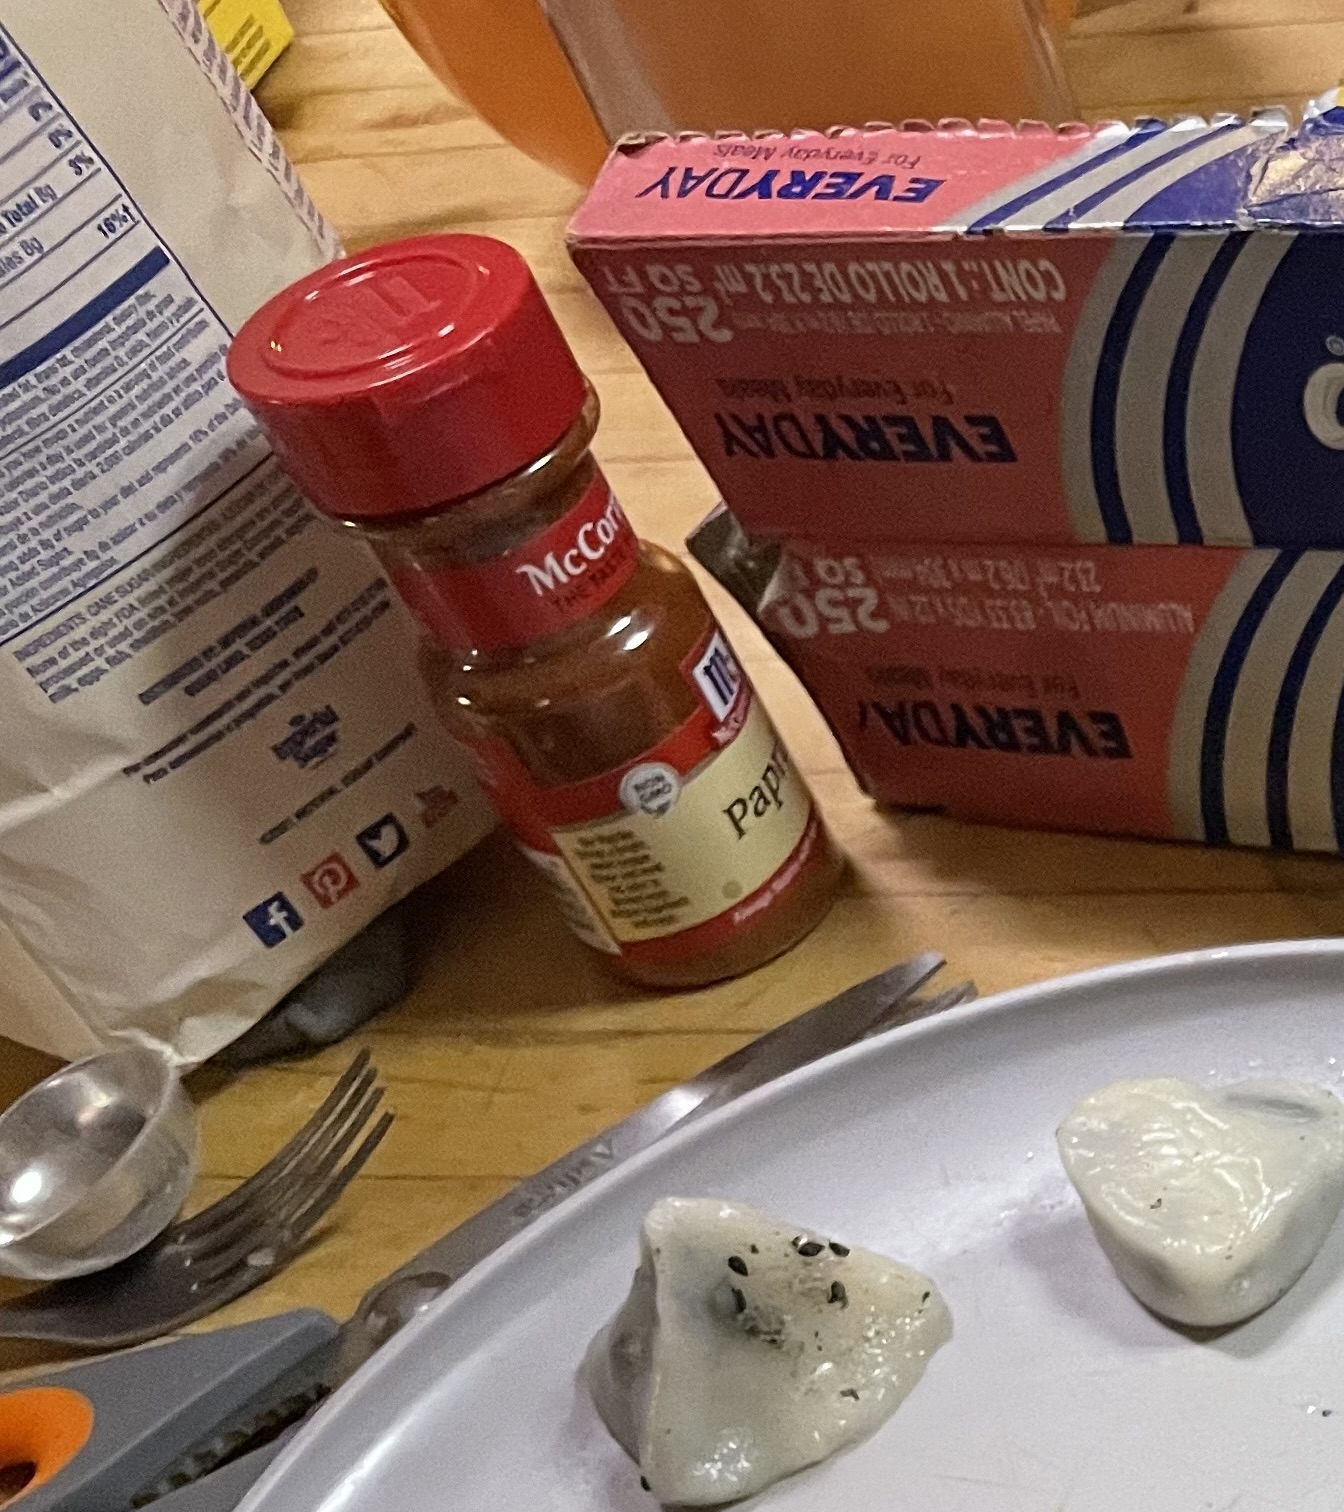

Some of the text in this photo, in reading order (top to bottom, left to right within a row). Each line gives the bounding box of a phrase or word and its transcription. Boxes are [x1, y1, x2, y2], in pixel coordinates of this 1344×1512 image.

[712, 143, 922, 170] For Everyday Meals
[634, 166, 947, 204] EVERYDAY
[601, 264, 647, 295] FT
[645, 264, 703, 294] SQ
[802, 262, 852, 303] DE
[848, 260, 949, 303] ROLLO
[620, 296, 733, 343] 250
[711, 410, 1014, 466] EVERYDAY
[778, 556, 889, 638] 250 SQ
